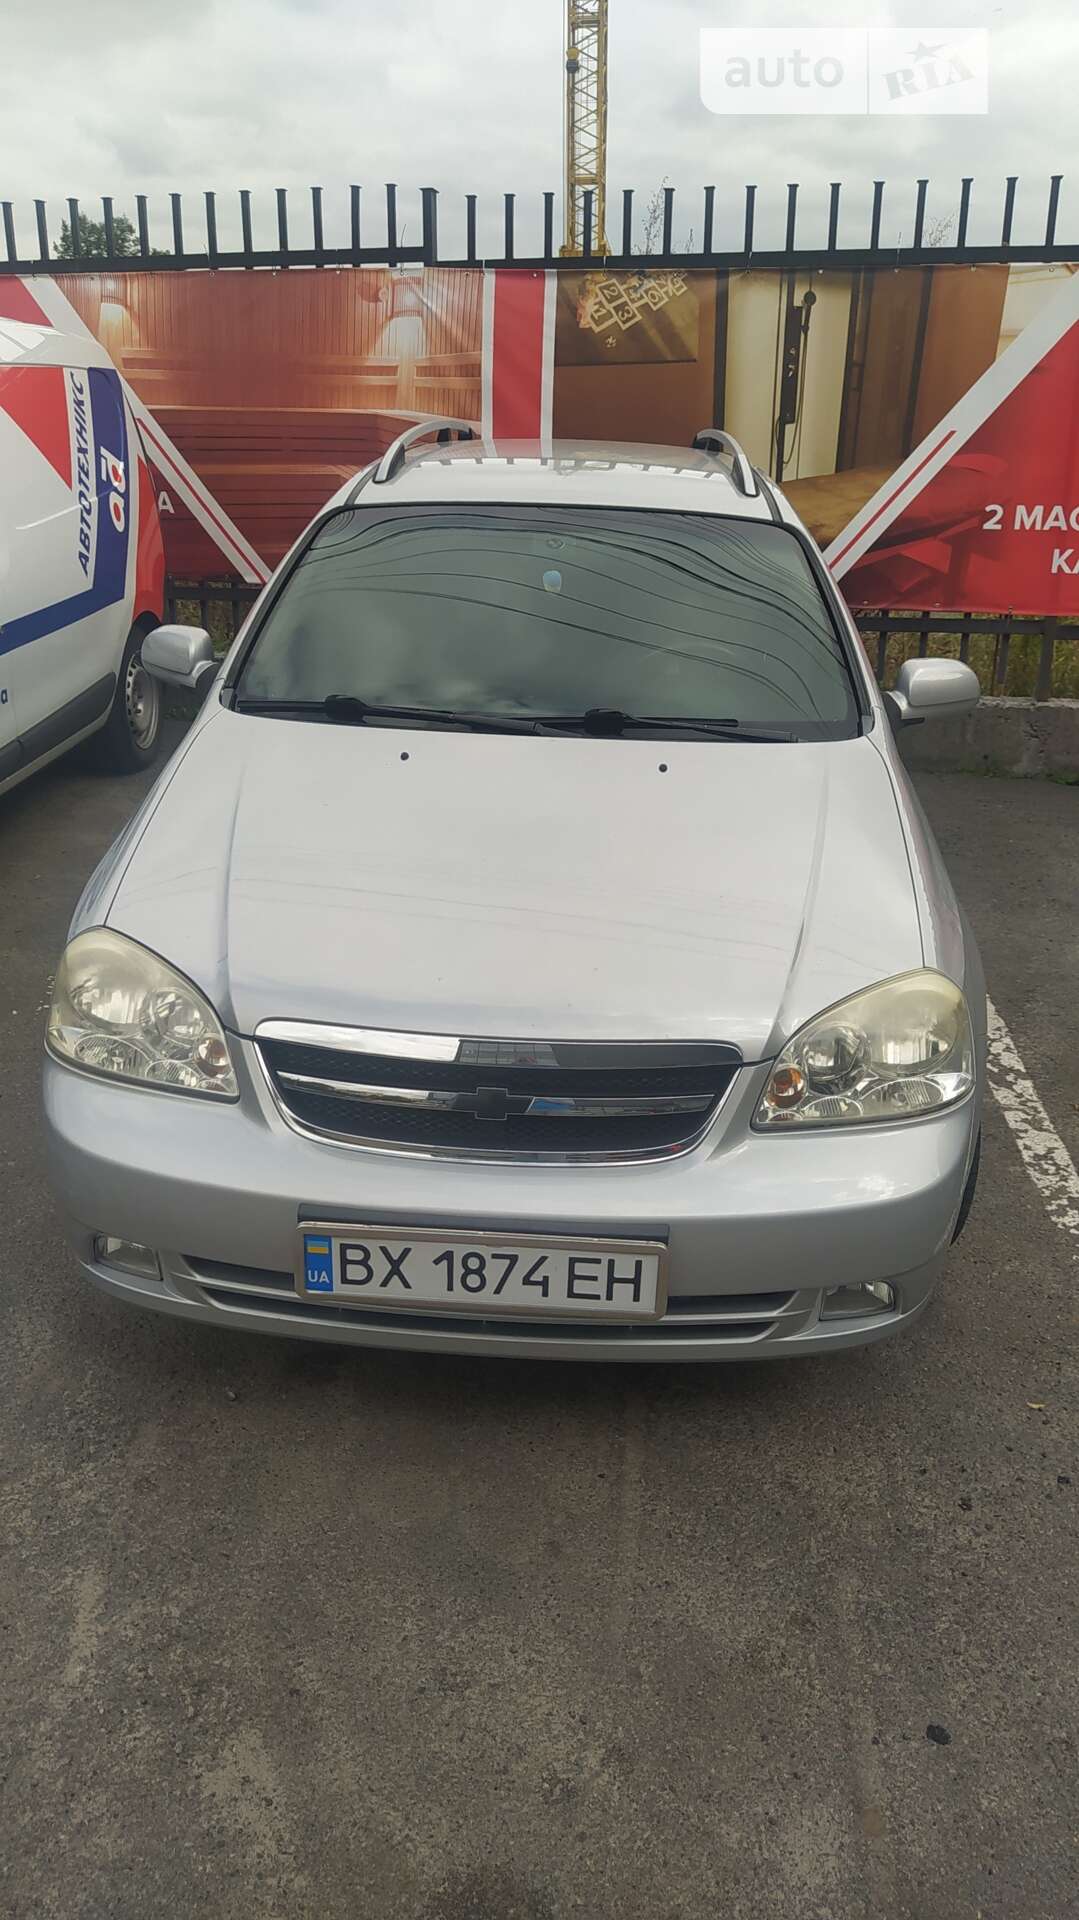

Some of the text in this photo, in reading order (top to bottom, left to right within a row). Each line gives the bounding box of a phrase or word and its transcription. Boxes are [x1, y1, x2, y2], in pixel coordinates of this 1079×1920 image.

[70, 371, 92, 577] АВТОТЕХНІКС
[982, 504, 1004, 530] 2
[308, 1269, 330, 1284] UA
[432, 1250, 549, 1298] 1874
